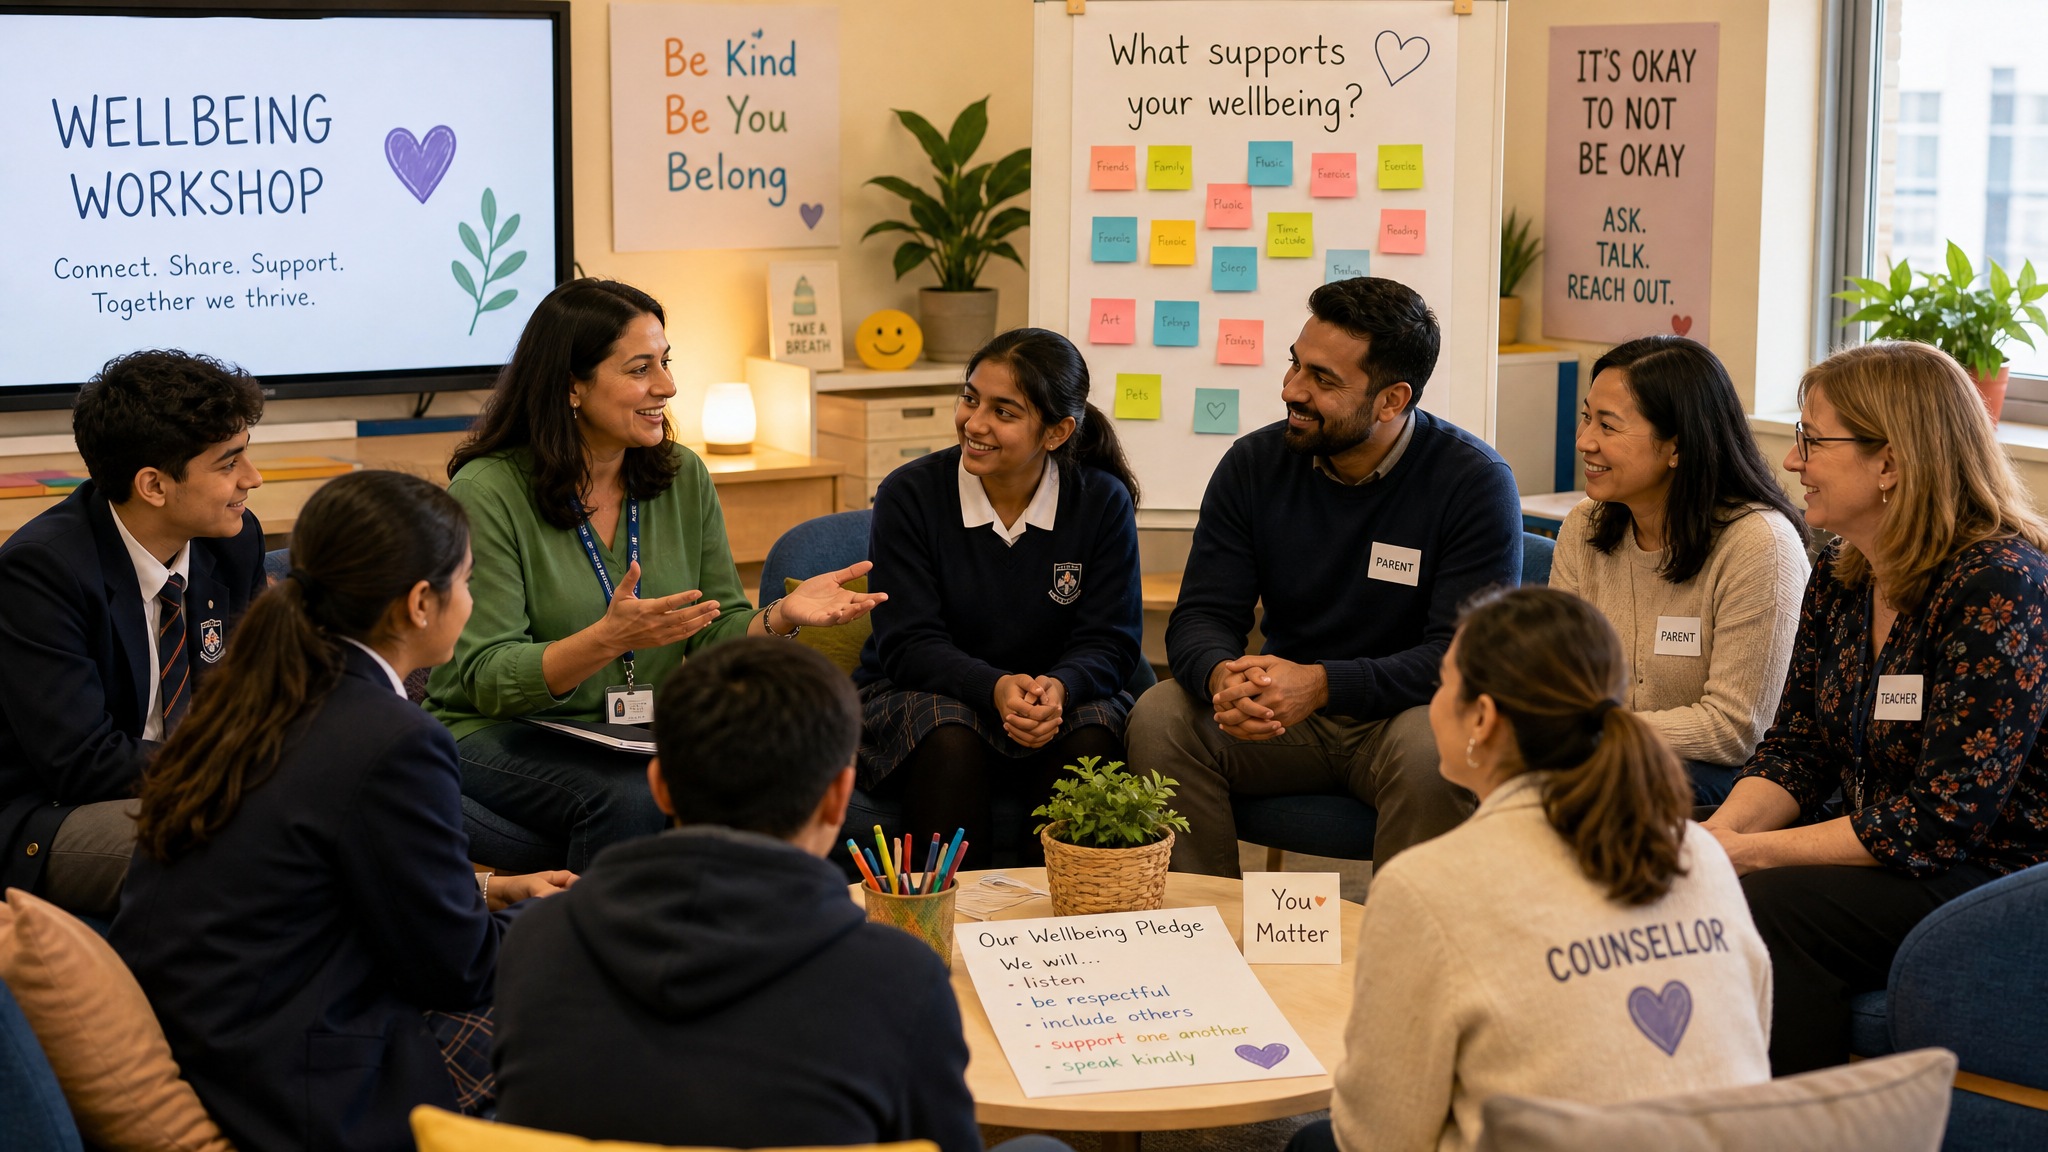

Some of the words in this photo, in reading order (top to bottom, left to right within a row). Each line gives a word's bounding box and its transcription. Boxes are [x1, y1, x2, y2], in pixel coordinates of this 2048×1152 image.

[665, 38, 708, 77] Be
[726, 38, 797, 77] Kind
[1109, 32, 1189, 65] What
[1209, 35, 1344, 78] supports
[1578, 48, 1620, 82] IT'S
[1633, 49, 1696, 83] OKAY
[666, 94, 709, 134] Be
[727, 95, 787, 134] You
[1128, 97, 1192, 130] your
[1209, 83, 1362, 132] wellbeing?
[1583, 97, 1613, 129] TO
[1626, 97, 1676, 130] NOT
[52, 94, 332, 148] WELLBEING
[1097, 160, 1129, 171] Friends
[1154, 161, 1184, 175] Family
[1580, 142, 1607, 175] BE
[1620, 144, 1685, 177] OKAY
[669, 152, 787, 207] Belong
[71, 167, 323, 219] WORKSHOP
[1276, 224, 1298, 233] Time
[1603, 207, 1645, 233] ASK.
[55, 257, 156, 279] Connect.
[170, 254, 239, 276] Share.
[252, 252, 343, 280] Support.
[1596, 242, 1649, 268] TALK.
[1221, 262, 1246, 276] Sleep
[1568, 274, 1624, 302] REACH
[1634, 279, 1673, 305] OUT.
[92, 290, 195, 320] Together
[206, 296, 234, 309] we
[246, 287, 314, 307] thrive.
[788, 322, 816, 336] TAKE
[819, 322, 828, 336] A
[1101, 313, 1120, 324] Art
[786, 340, 830, 354] BREATH
[1126, 388, 1148, 400] Pets
[1376, 557, 1414, 572] PARENT
[1661, 631, 1695, 642] PARENT
[1881, 693, 1917, 704] TEACHER
[1272, 889, 1311, 910] You
[979, 933, 1018, 947] Our
[1028, 926, 1127, 943] Wellbeing
[1136, 919, 1203, 938] Pledge
[1257, 923, 1329, 942] Matter
[1546, 919, 1729, 982] COUNSELLOR
[1000, 957, 1032, 970] We
[1024, 976, 1084, 988] listen
[1031, 997, 1056, 1007] be
[1067, 985, 1170, 1006] respectful
[1041, 1012, 1116, 1028] include
[1129, 1009, 1193, 1021] others
[1052, 1033, 1125, 1052] support
[1137, 1033, 1169, 1042] one
[1179, 1025, 1248, 1039] another
[1063, 1056, 1122, 1074] speak
[1132, 1051, 1194, 1066] kindly
